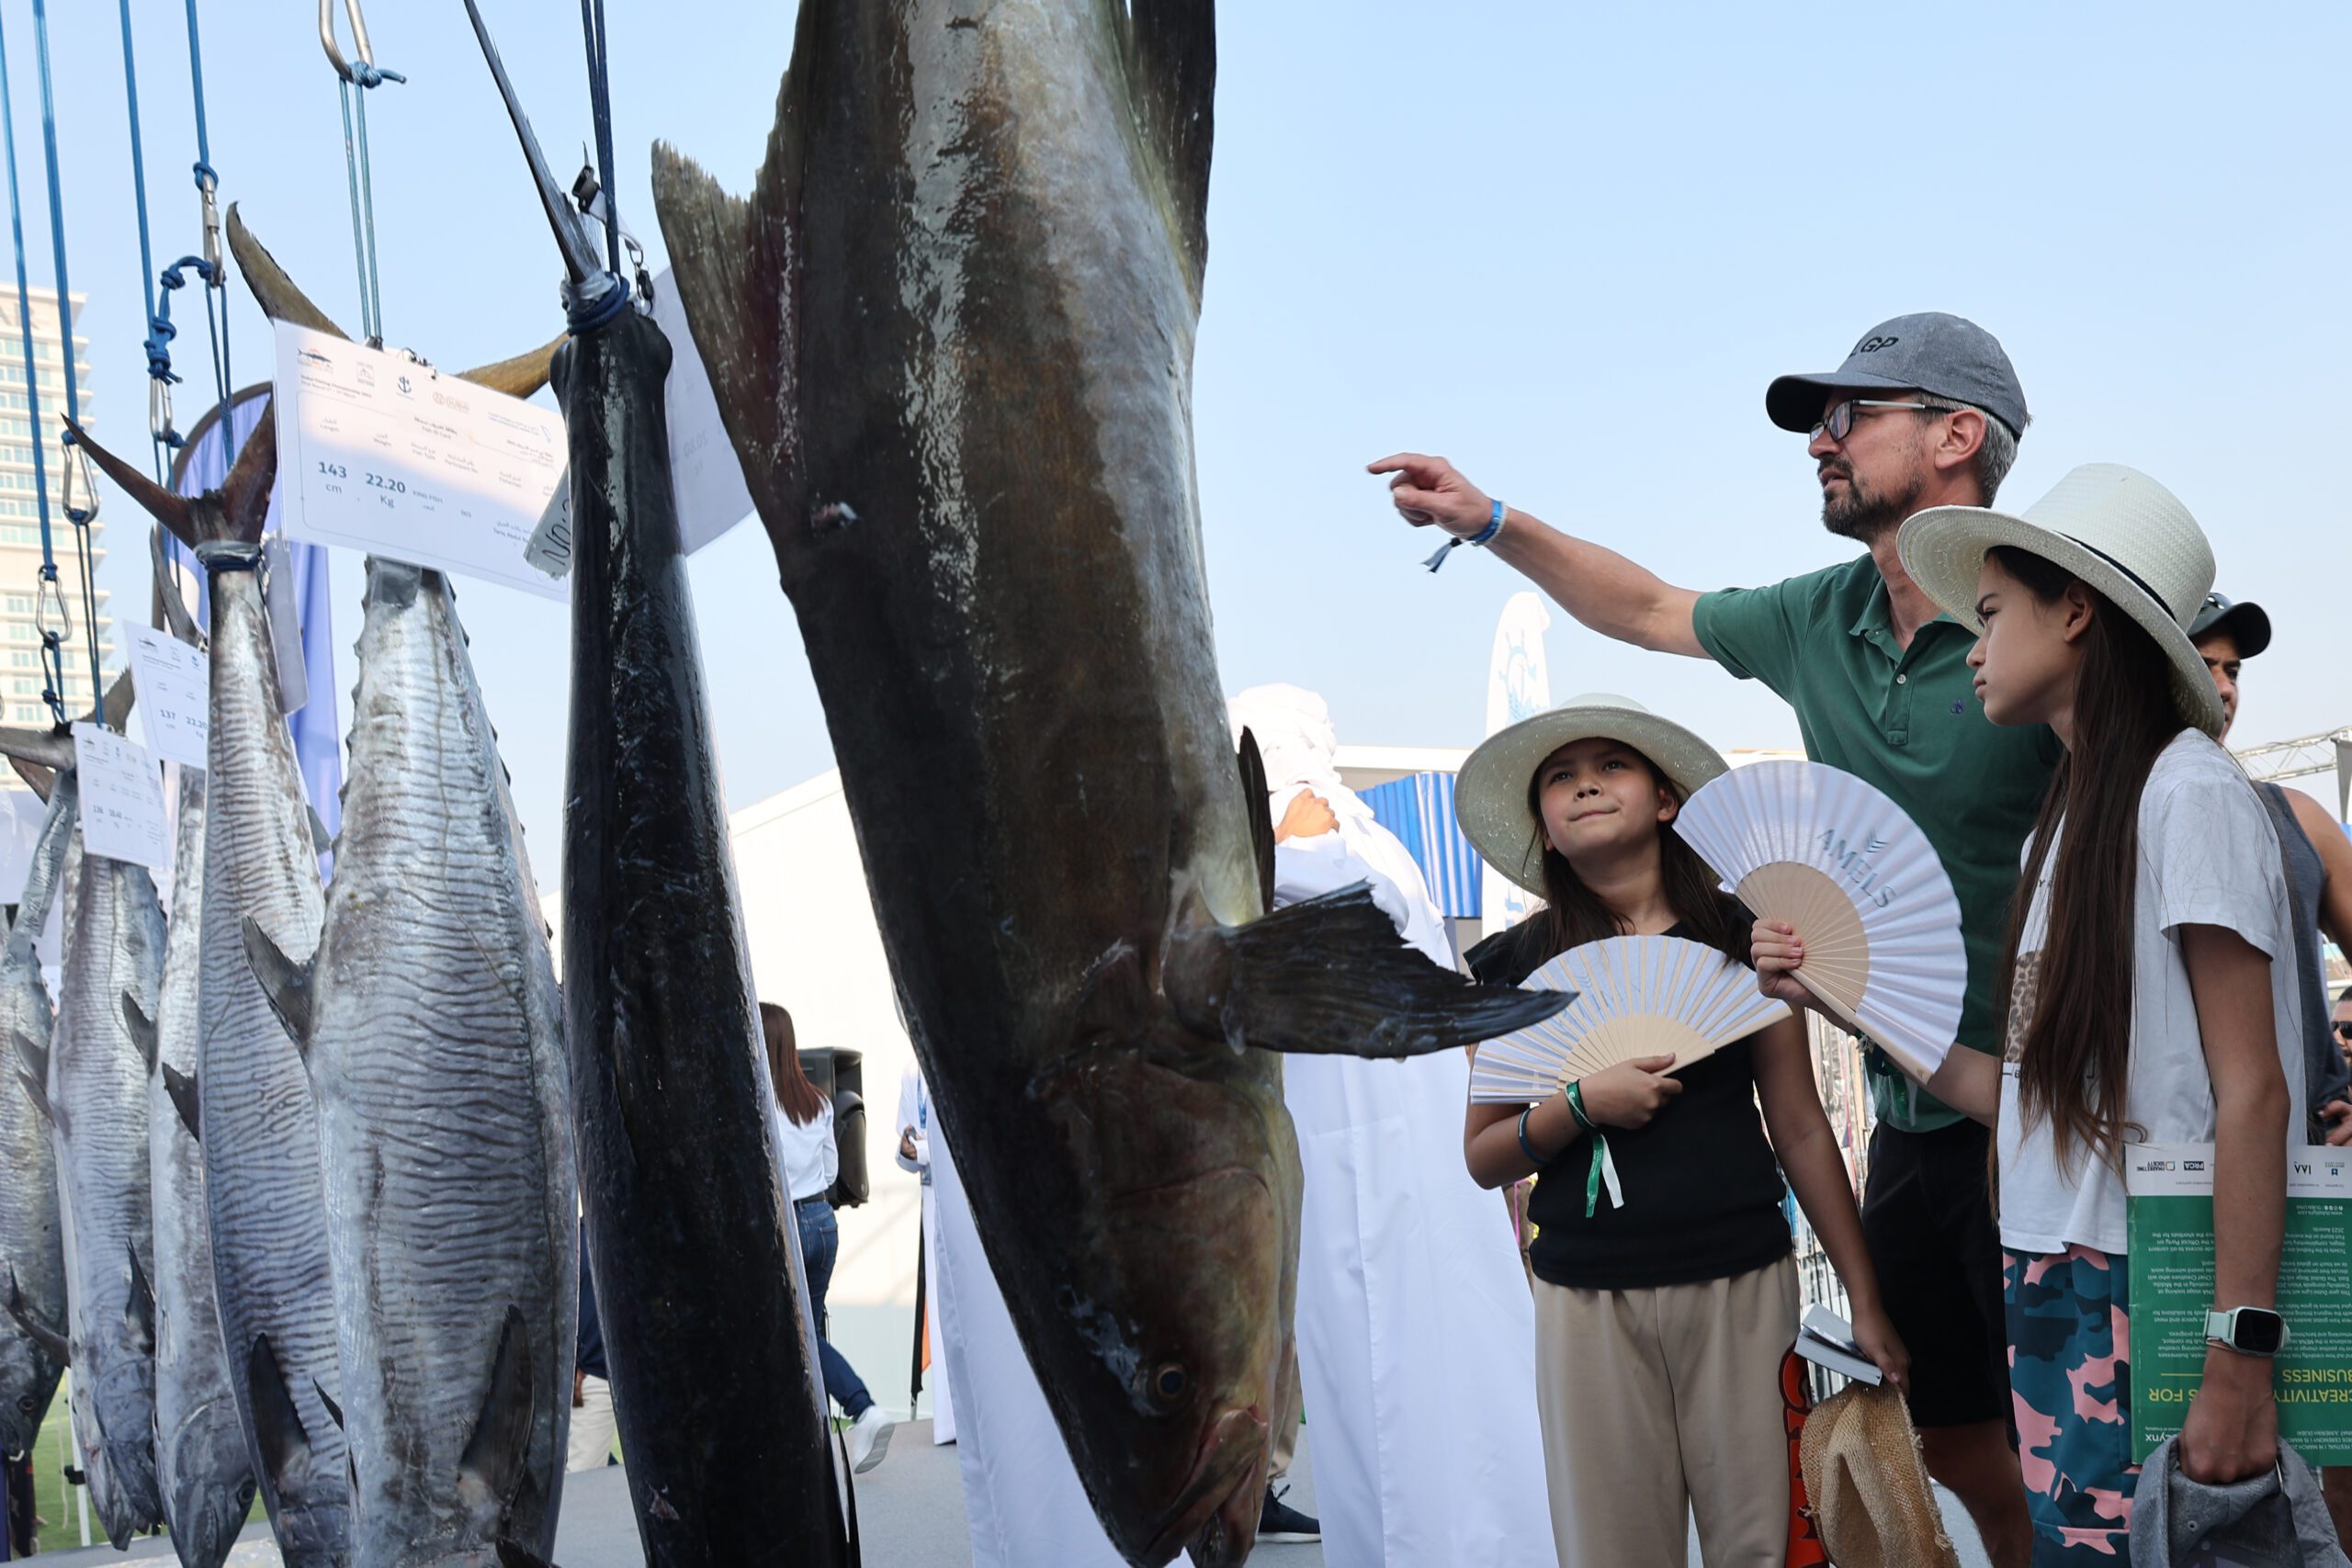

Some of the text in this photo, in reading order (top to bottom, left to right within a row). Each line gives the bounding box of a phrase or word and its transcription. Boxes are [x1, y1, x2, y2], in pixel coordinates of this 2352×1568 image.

[319, 462, 347, 479] 143
[325, 484, 343, 493] cm
[366, 472, 406, 494] 22.20
[380, 494, 394, 509] Kg
[1815, 829, 1897, 908] AMELS
[2293, 1164, 2312, 1175] IAA
[2149, 1389, 2184, 1402] FOR
